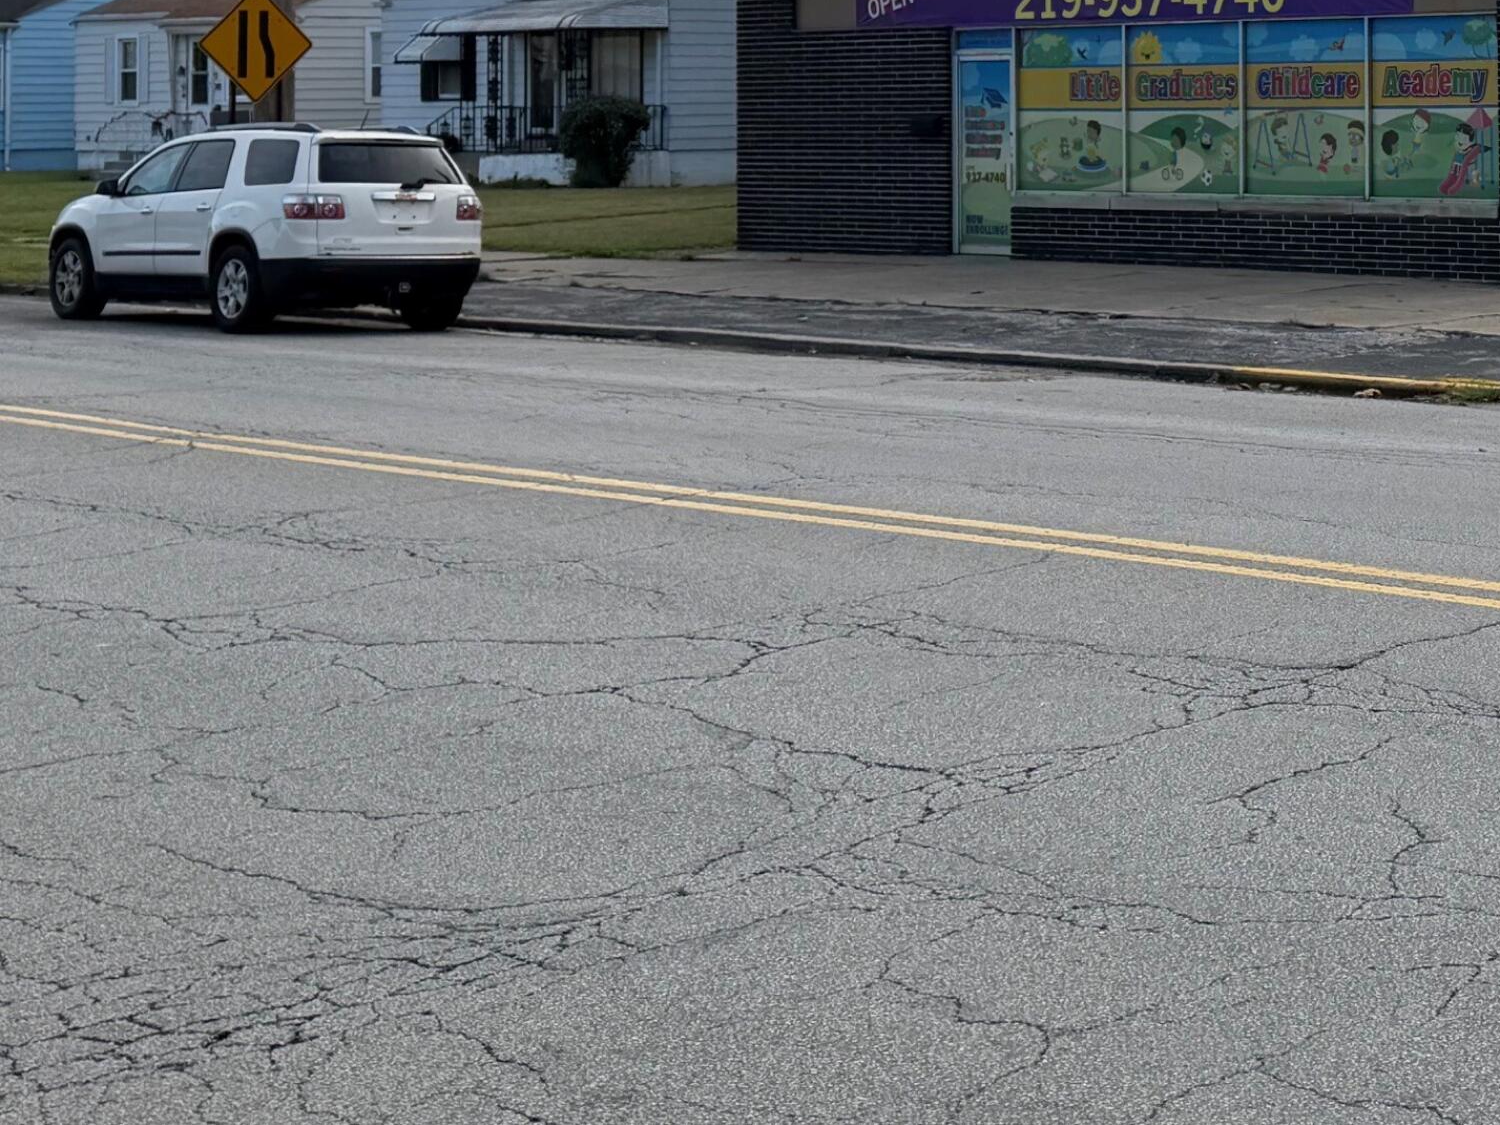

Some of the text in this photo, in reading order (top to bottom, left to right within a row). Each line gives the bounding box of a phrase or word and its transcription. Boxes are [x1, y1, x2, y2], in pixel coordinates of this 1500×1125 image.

[1069, 63, 1488, 103] Little Graduates Childcare Academy
